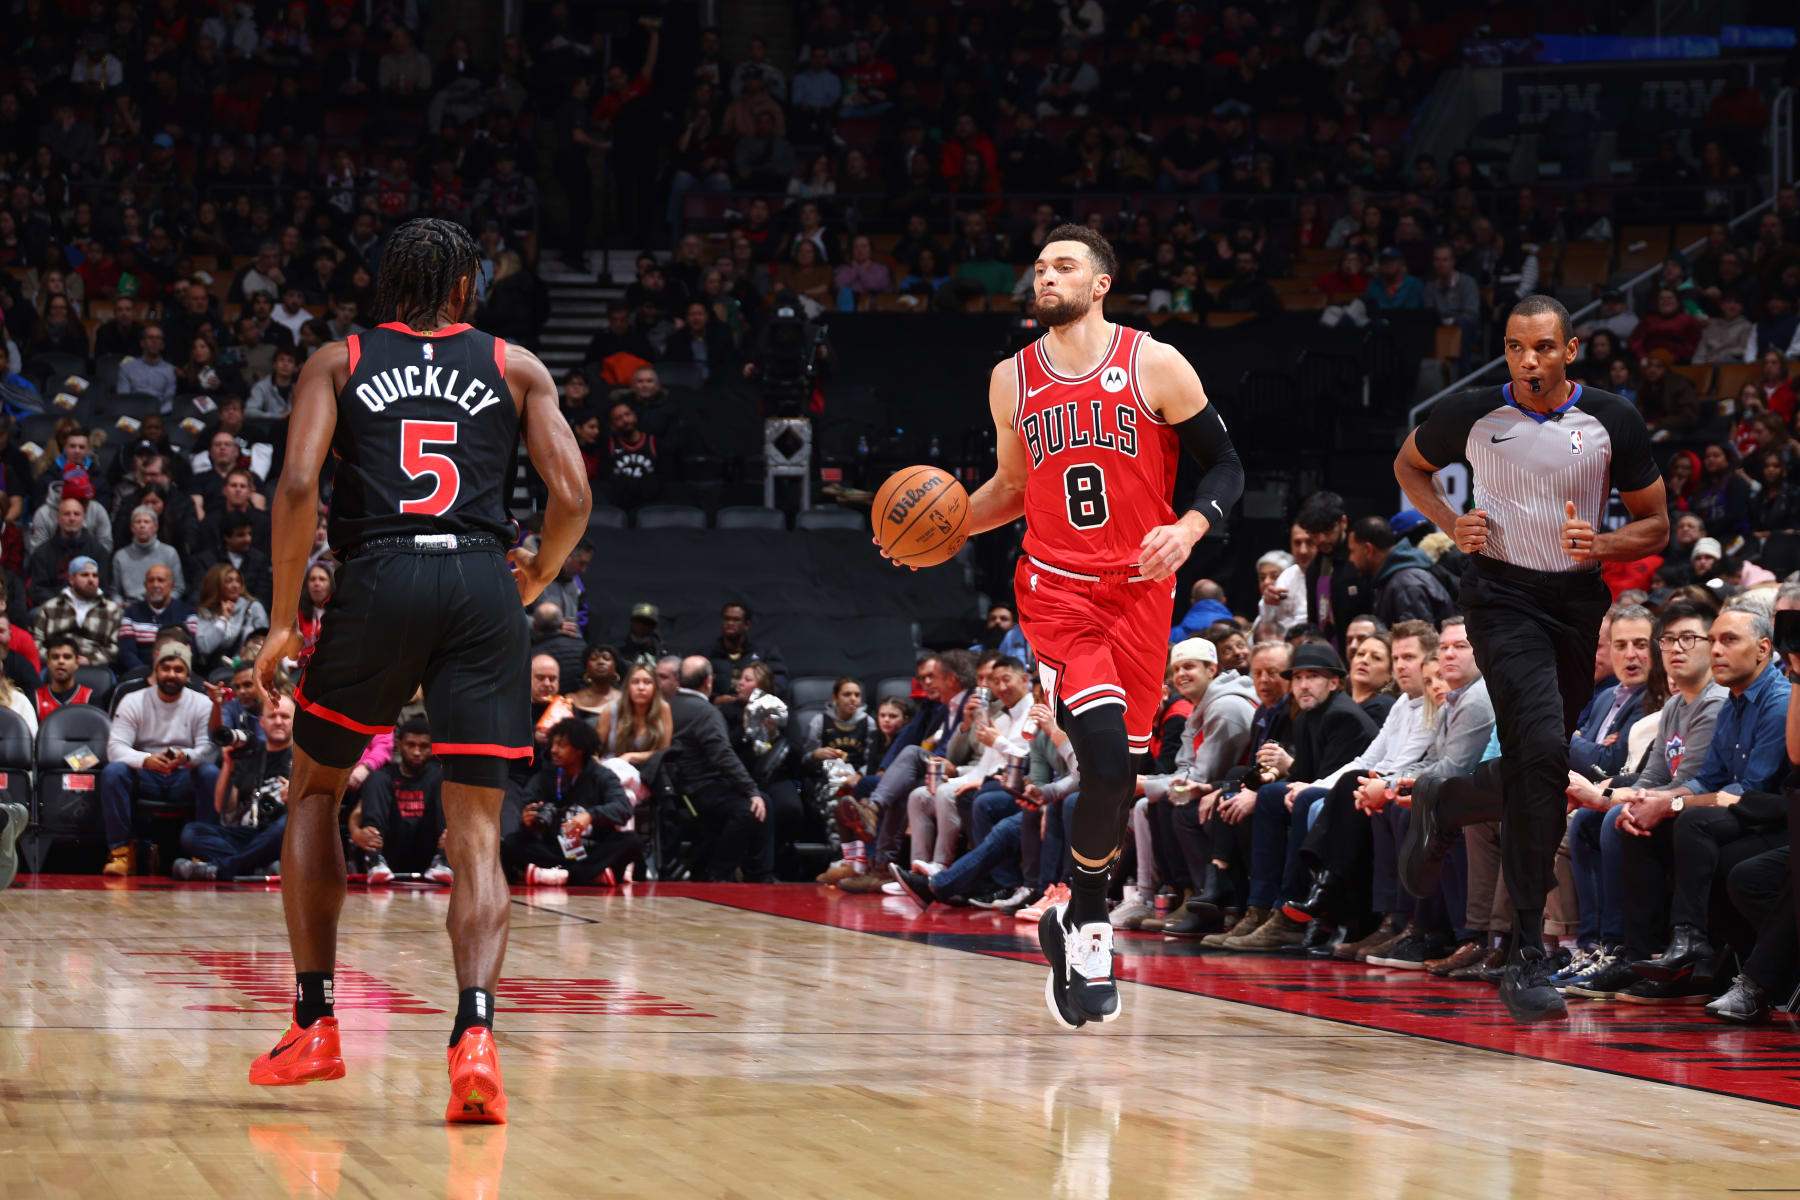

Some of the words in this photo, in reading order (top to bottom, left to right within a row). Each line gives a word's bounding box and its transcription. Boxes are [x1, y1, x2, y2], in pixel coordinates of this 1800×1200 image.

[356, 365, 501, 416] QUICKLEY
[399, 419, 461, 517] 5
[1022, 400, 1138, 470] BULLS
[887, 476, 944, 525] Wilson
[1063, 462, 1110, 531] 8
